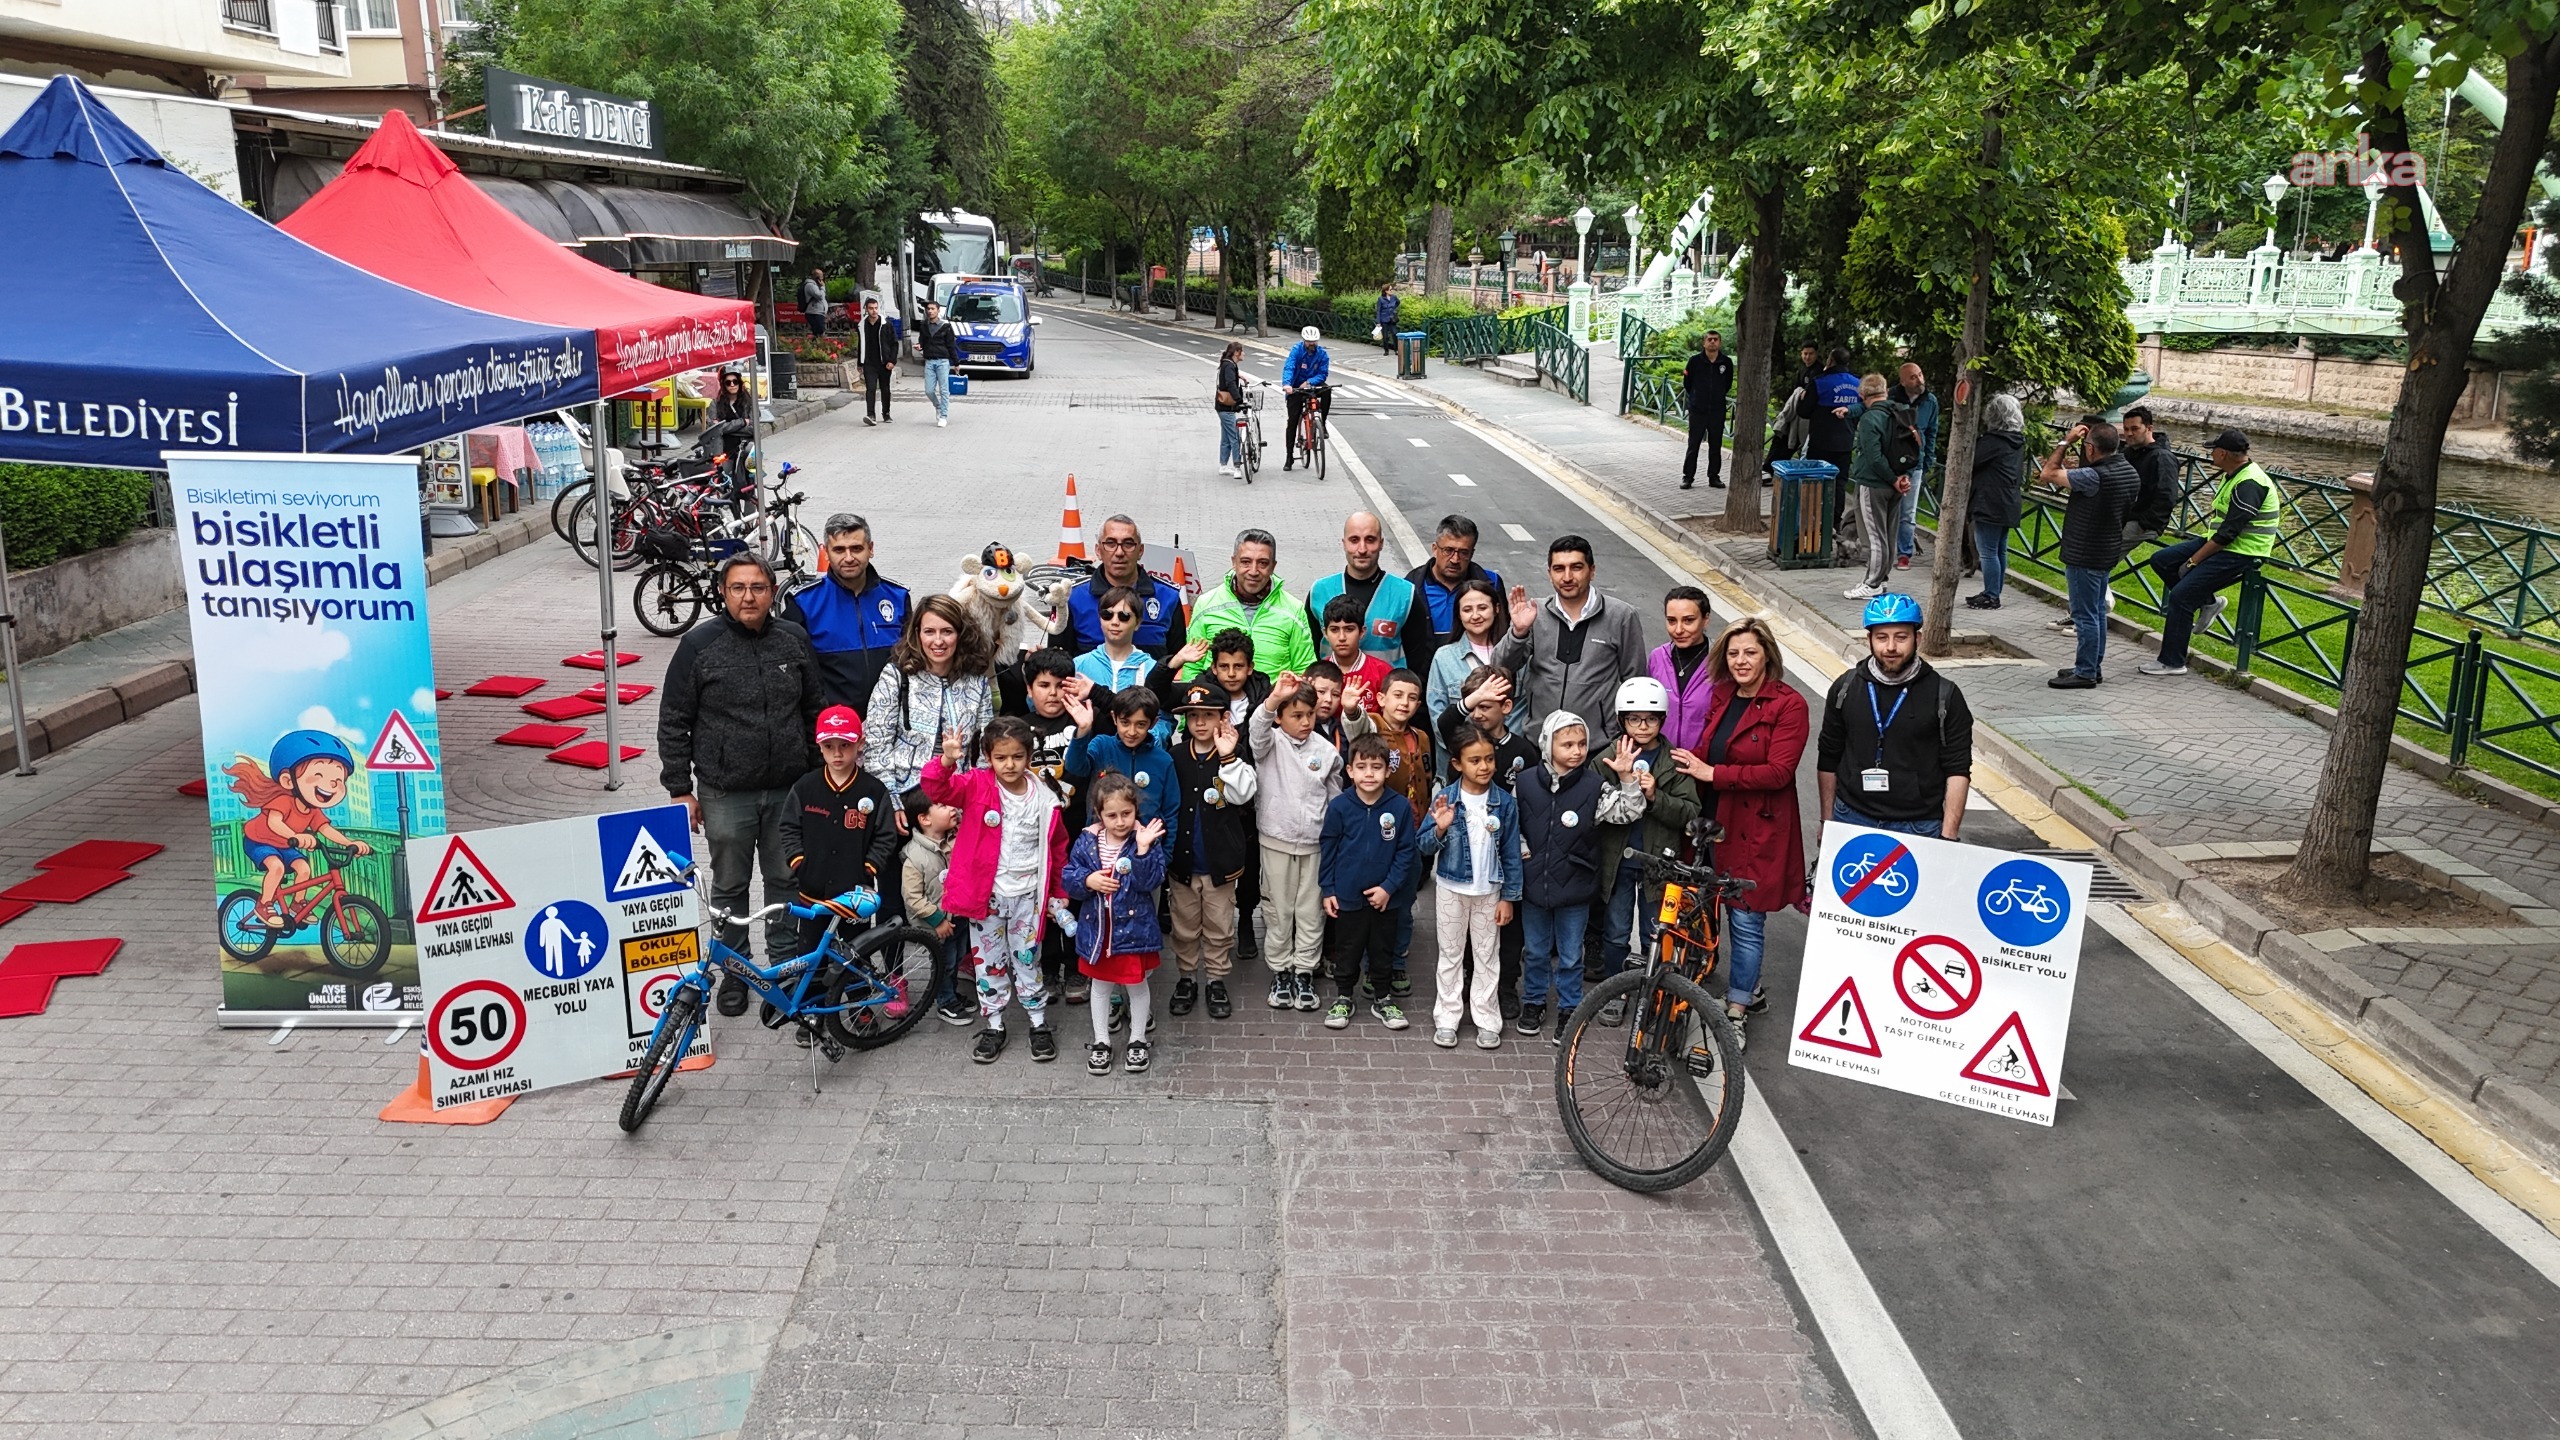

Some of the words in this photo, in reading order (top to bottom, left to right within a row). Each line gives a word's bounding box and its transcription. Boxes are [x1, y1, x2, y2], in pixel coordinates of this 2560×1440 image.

[518, 84, 580, 138] Kafe
[582, 98, 653, 149] DENGİ
[333, 365, 433, 443] Hayallerin
[434, 357, 485, 425] gerçeğe
[486, 347, 553, 399] dönüştüğü
[553, 336, 583, 389] şehir
[0, 387, 239, 446] BELEDİYESİ
[186, 488, 277, 506] Bisikletimi
[282, 491, 381, 509] seviyorum
[191, 510, 381, 550] bisikletli
[198, 550, 402, 594] ulaşımla
[200, 591, 415, 626] tanışıyorum
[621, 901, 648, 917] YAYA
[650, 892, 684, 913] GEÇİDİ
[435, 921, 459, 938] YAYA
[461, 913, 494, 934] GEÇİDİ
[632, 917, 678, 934] LEVHASI
[1818, 910, 1866, 927] MECBURİ
[1868, 920, 1918, 937] BİSİKLET
[424, 938, 473, 960] YAKLAŞIM
[474, 931, 514, 952] LEVHASI
[639, 938, 680, 952] OKUL
[1836, 927, 1863, 941] YOLU
[1865, 932, 1896, 946] SONU
[630, 946, 692, 970] BÖLGESİ
[2000, 946, 2052, 963] MECBURİ
[1981, 955, 2033, 974] BİSİKLET
[2037, 966, 2067, 980] YOLU
[308, 992, 347, 1004] ÜNLÜCE
[321, 984, 346, 995] AYŞE
[403, 993, 423, 1001] BÜYÜ
[523, 979, 581, 1002] MECBURİ
[584, 976, 615, 992] YAYA
[553, 999, 588, 1016] YOLU
[450, 1002, 508, 1047] 50
[1883, 1025, 1915, 1039] TAŞIT
[1900, 1016, 1953, 1034] MOTORLU
[628, 1038, 650, 1053] OKU
[1794, 1049, 1833, 1065] DİKKAT
[1835, 1058, 1881, 1076] LEVHASI
[450, 1071, 490, 1090] AZAMİ
[493, 1066, 515, 1081] HIZ
[437, 1093, 476, 1108] SINIRI
[479, 1079, 532, 1100] LEVHASI
[2000, 1105, 2050, 1123] LEVHASI
